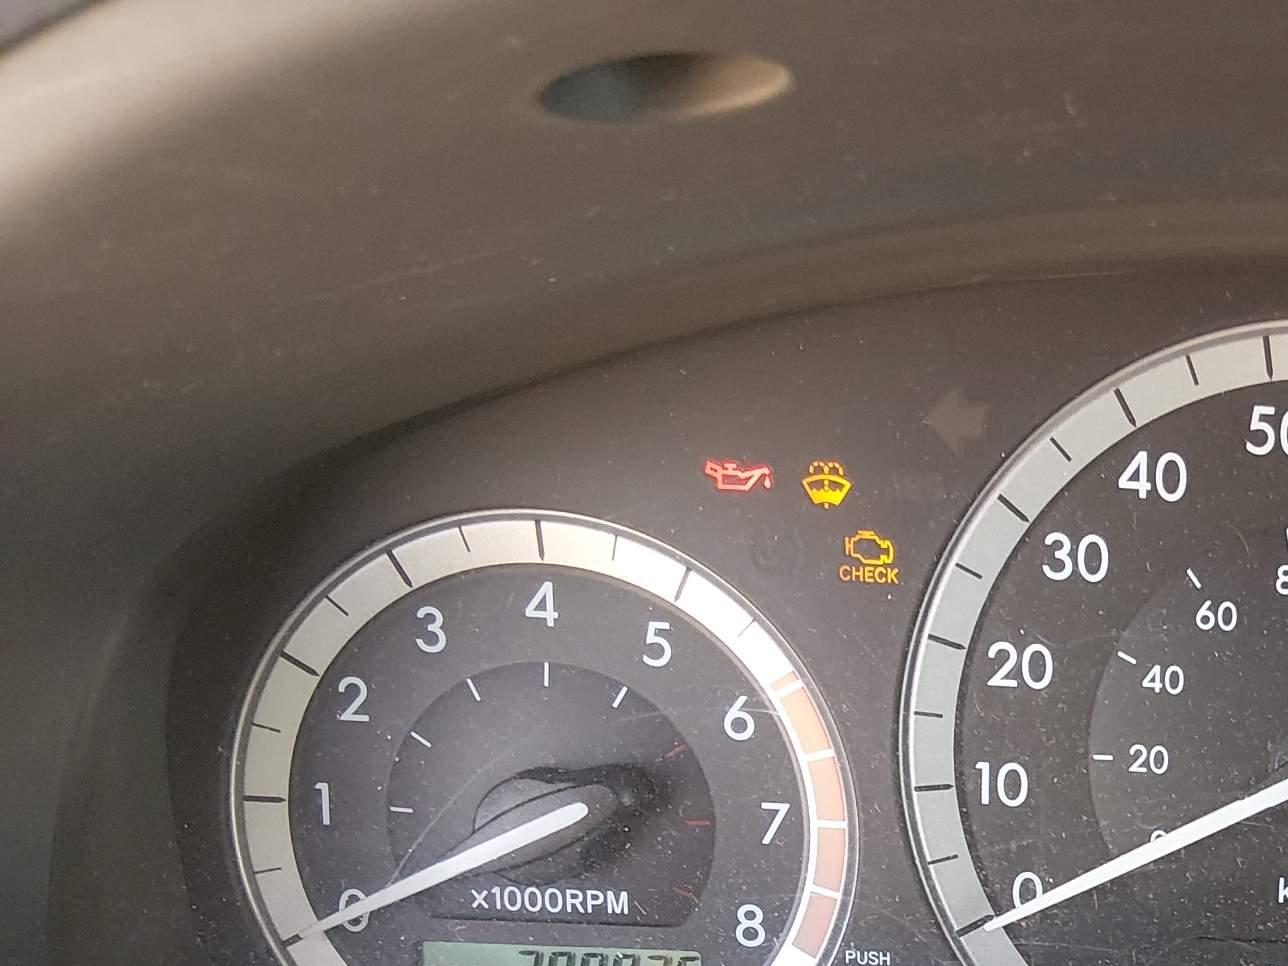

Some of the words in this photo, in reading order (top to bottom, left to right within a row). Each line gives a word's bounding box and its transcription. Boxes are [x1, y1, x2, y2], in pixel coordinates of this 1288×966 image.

[1118, 450, 1187, 502] 40
[839, 564, 899, 584] CHECK
[1042, 531, 1109, 583] 30
[525, 581, 559, 627] 4
[1195, 600, 1238, 632] 60
[415, 605, 447, 653] 3
[642, 621, 672, 667] 5
[986, 641, 1053, 690] 20
[1141, 664, 1185, 695] 40
[338, 676, 370, 722] 2
[723, 695, 755, 741] 6
[1128, 744, 1169, 775] 20
[314, 782, 331, 826] 1
[975, 761, 1029, 807] 10
[761, 802, 791, 845] 7
[338, 888, 369, 933] 0
[735, 903, 766, 948] 8
[845, 948, 891, 966] PUSH
